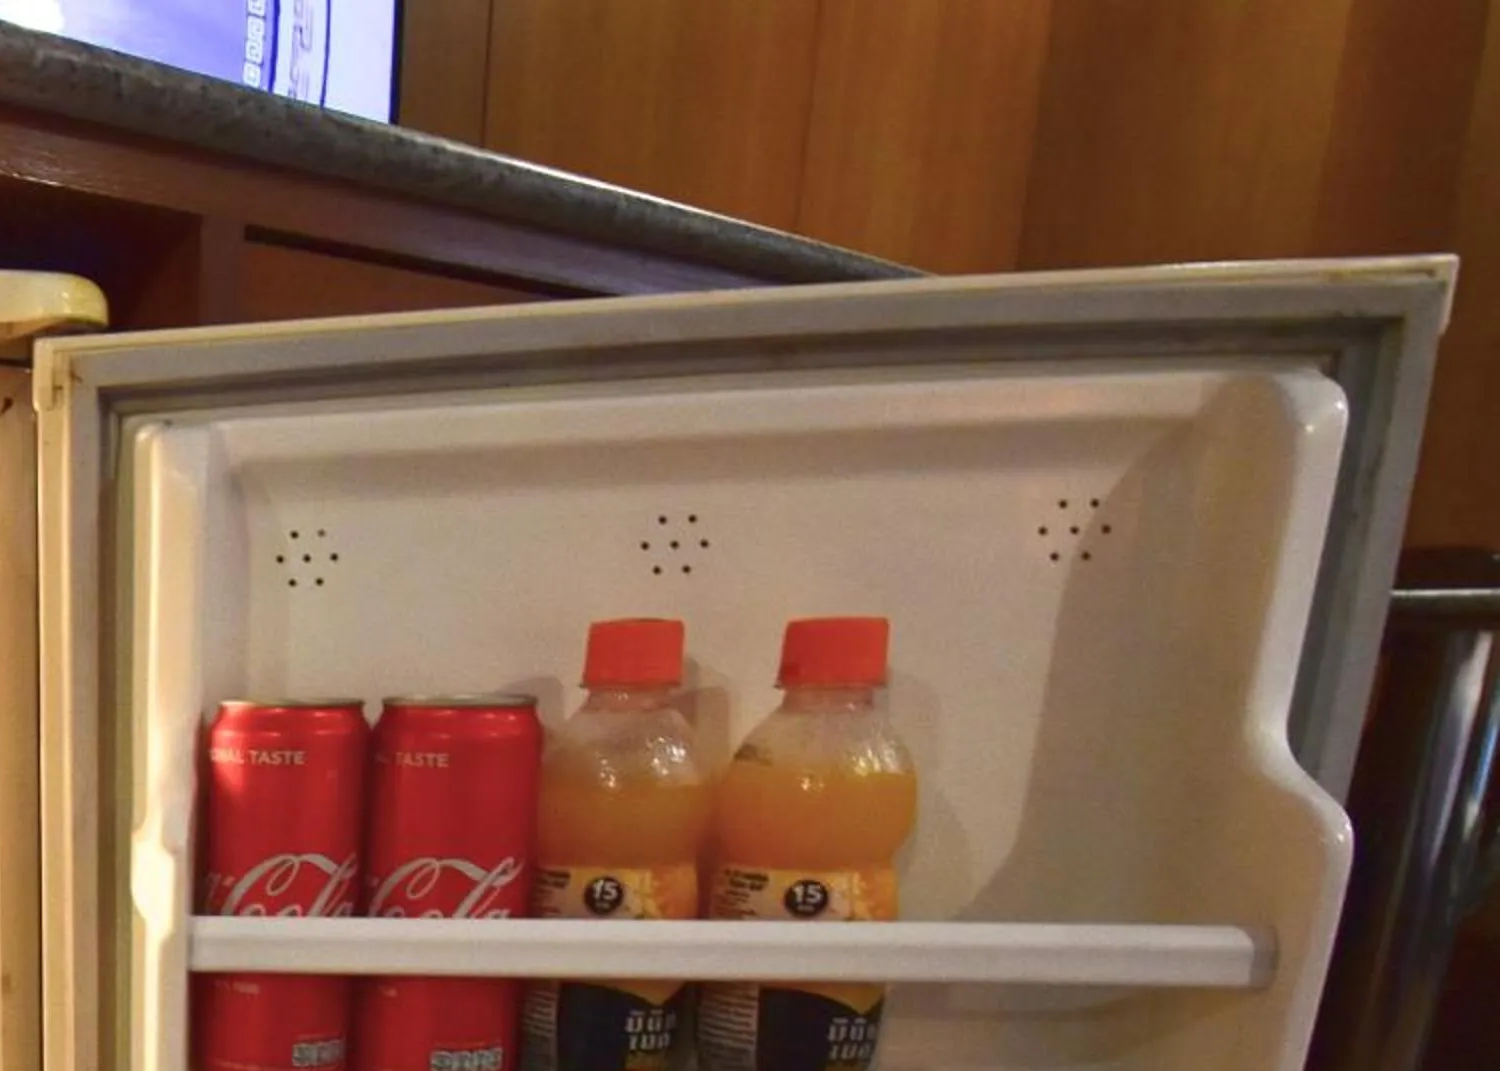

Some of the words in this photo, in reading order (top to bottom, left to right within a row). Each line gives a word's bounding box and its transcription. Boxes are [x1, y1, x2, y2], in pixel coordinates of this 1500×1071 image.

[248, 748, 306, 766] TASTE
[396, 752, 450, 768] TASTE
[592, 879, 619, 900] 15
[793, 883, 822, 903] 15
